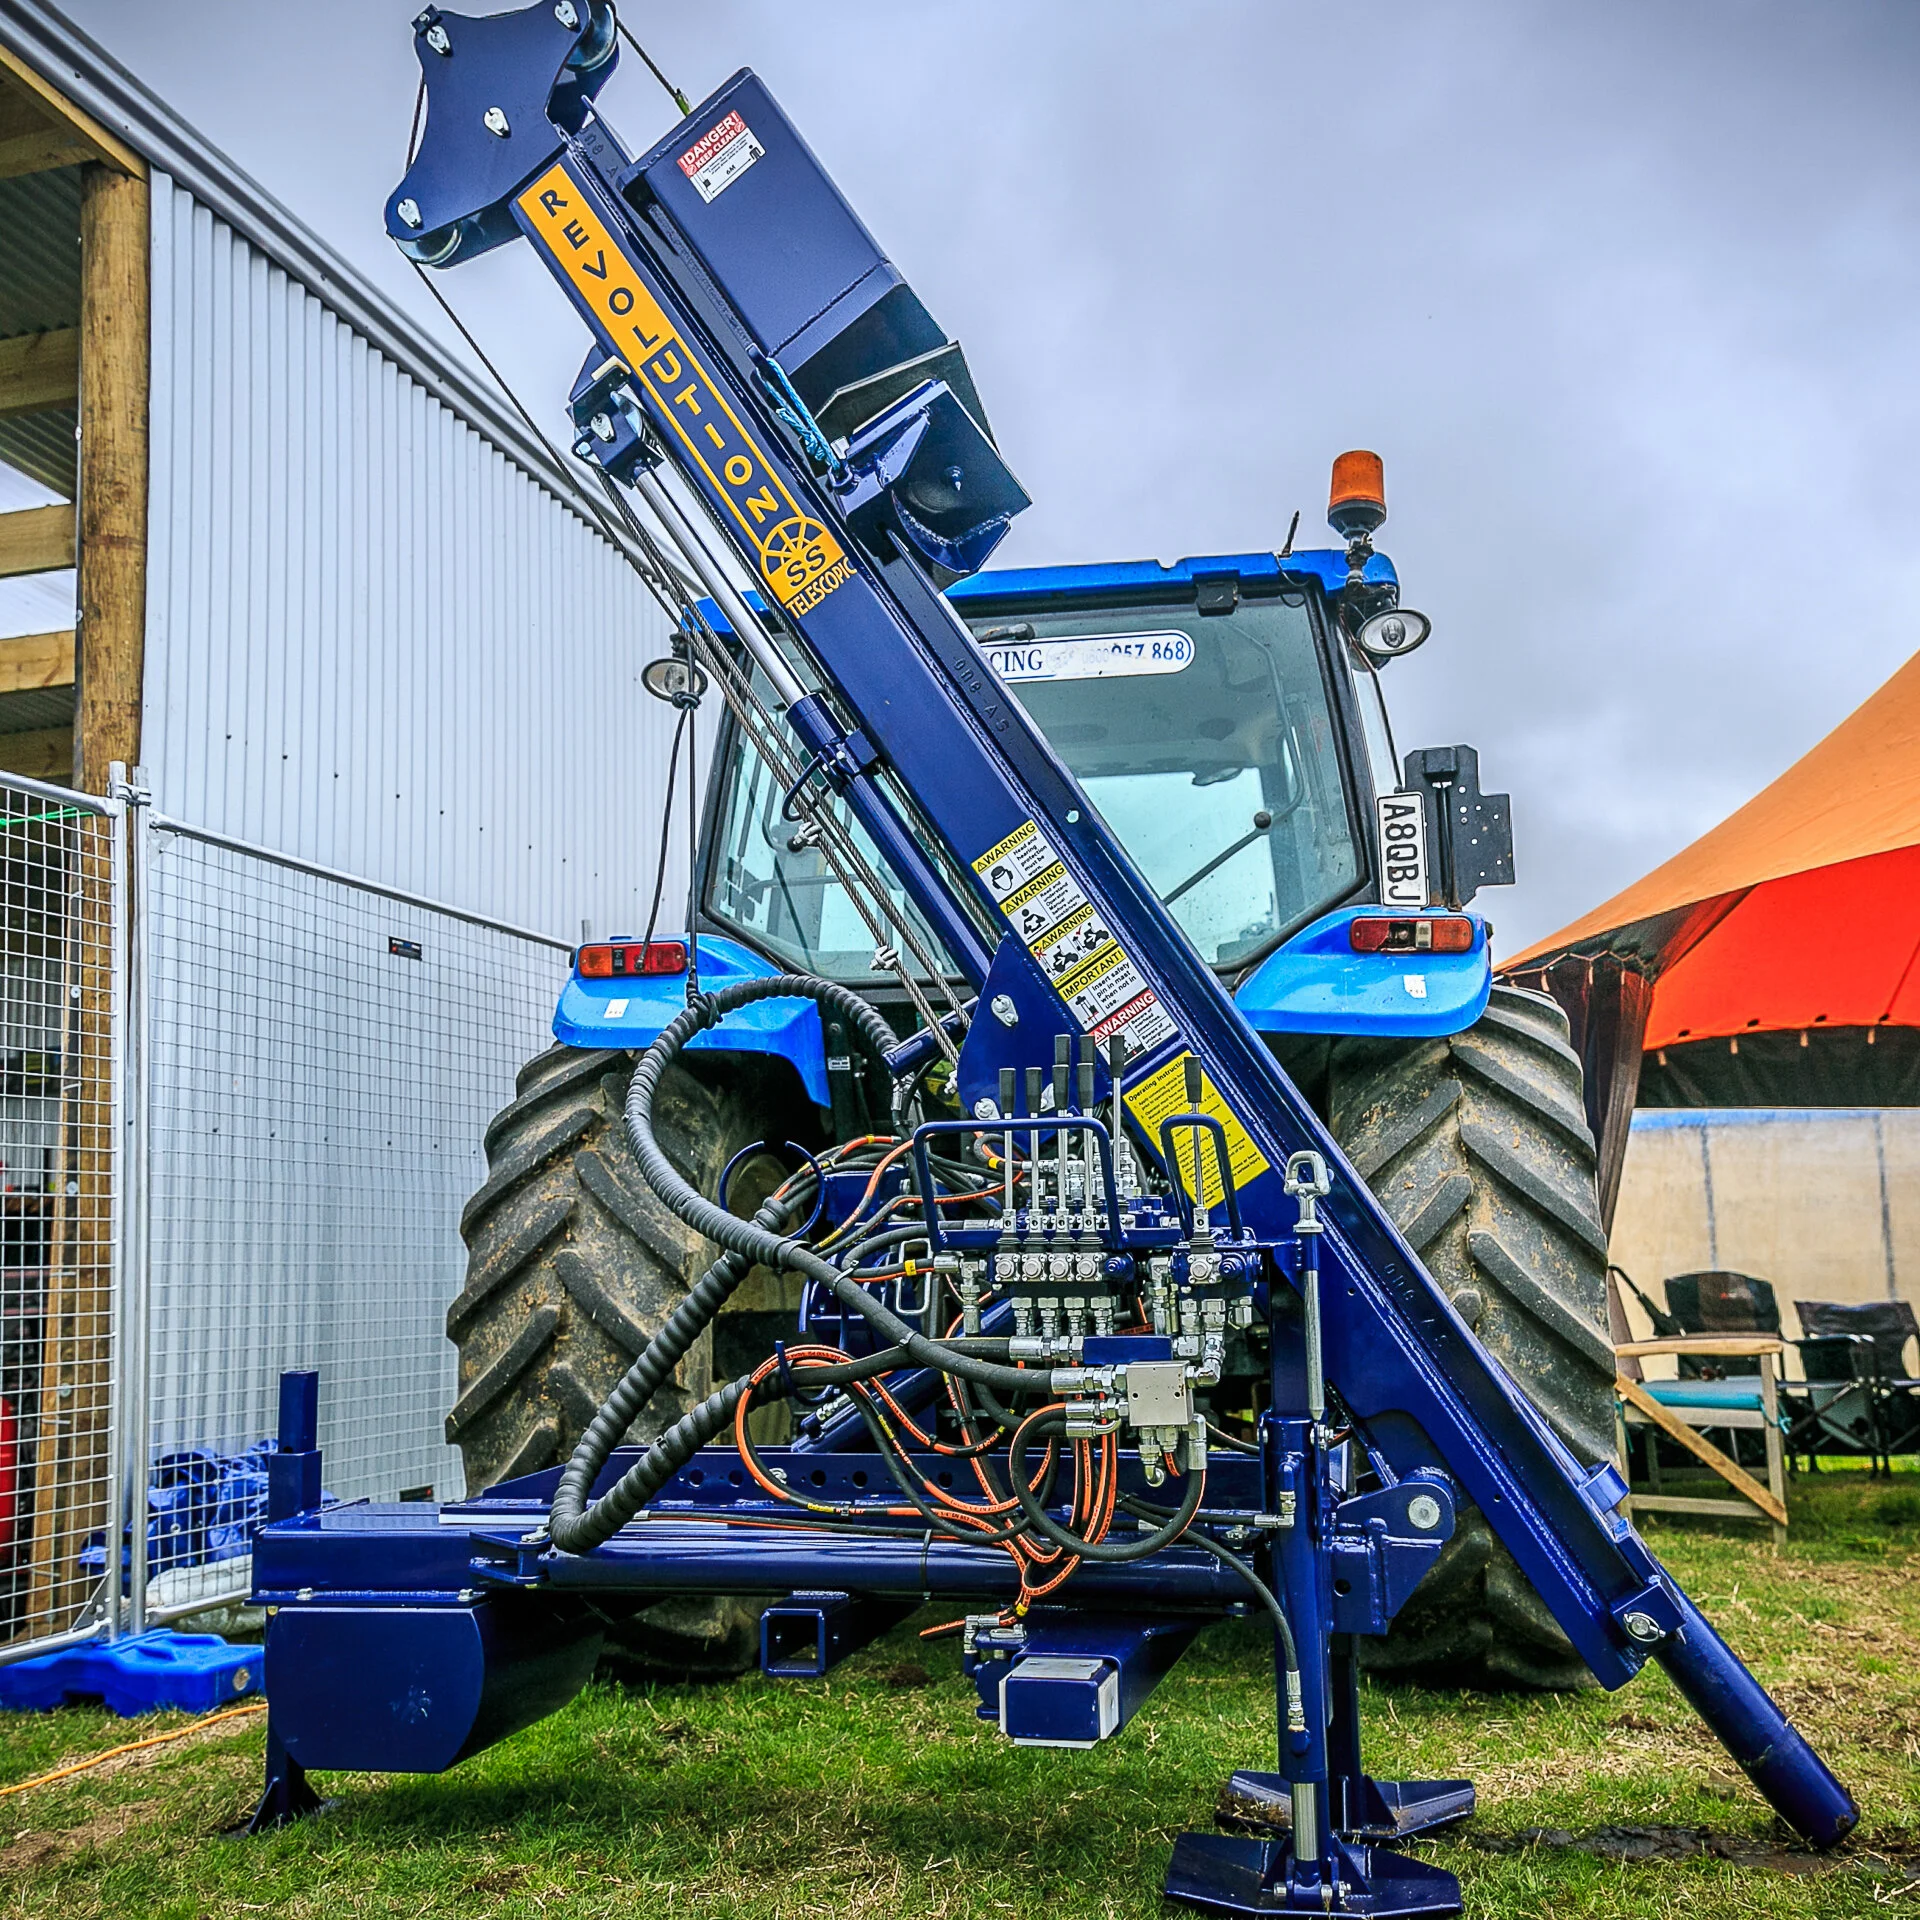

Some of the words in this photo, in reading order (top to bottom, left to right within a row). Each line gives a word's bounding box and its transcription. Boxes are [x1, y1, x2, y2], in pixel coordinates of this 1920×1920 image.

[695, 150, 714, 168] KEEP
[713, 130, 737, 152] CLEAR
[539, 189, 779, 523] REVOLUTION
[786, 545, 826, 587] SS
[786, 556, 857, 620] TELESCOPIC
[986, 648, 1043, 673] CING
[983, 822, 1036, 865] WARNING
[1013, 843, 1027, 855] Head
[1028, 836, 1037, 845] and
[1017, 845, 1037, 860] hearing
[1021, 845, 1047, 867] protection
[1384, 803, 1420, 900] A8QBJ
[1024, 860, 1037, 871] must
[1012, 864, 1064, 907] WARNING
[1048, 906, 1094, 943] WARNING
[1062, 950, 1123, 998] IMPORTANT!
[1092, 976, 1110, 990] Insert
[1111, 962, 1130, 978] safety
[1097, 988, 1107, 998] pin
[1114, 970, 1130, 984] mast
[1101, 989, 1118, 1003] when
[1118, 980, 1130, 990] not
[1105, 999, 1119, 1009] use.
[1101, 992, 1155, 1037] WARNING
[1128, 1080, 1157, 1101] Operating
